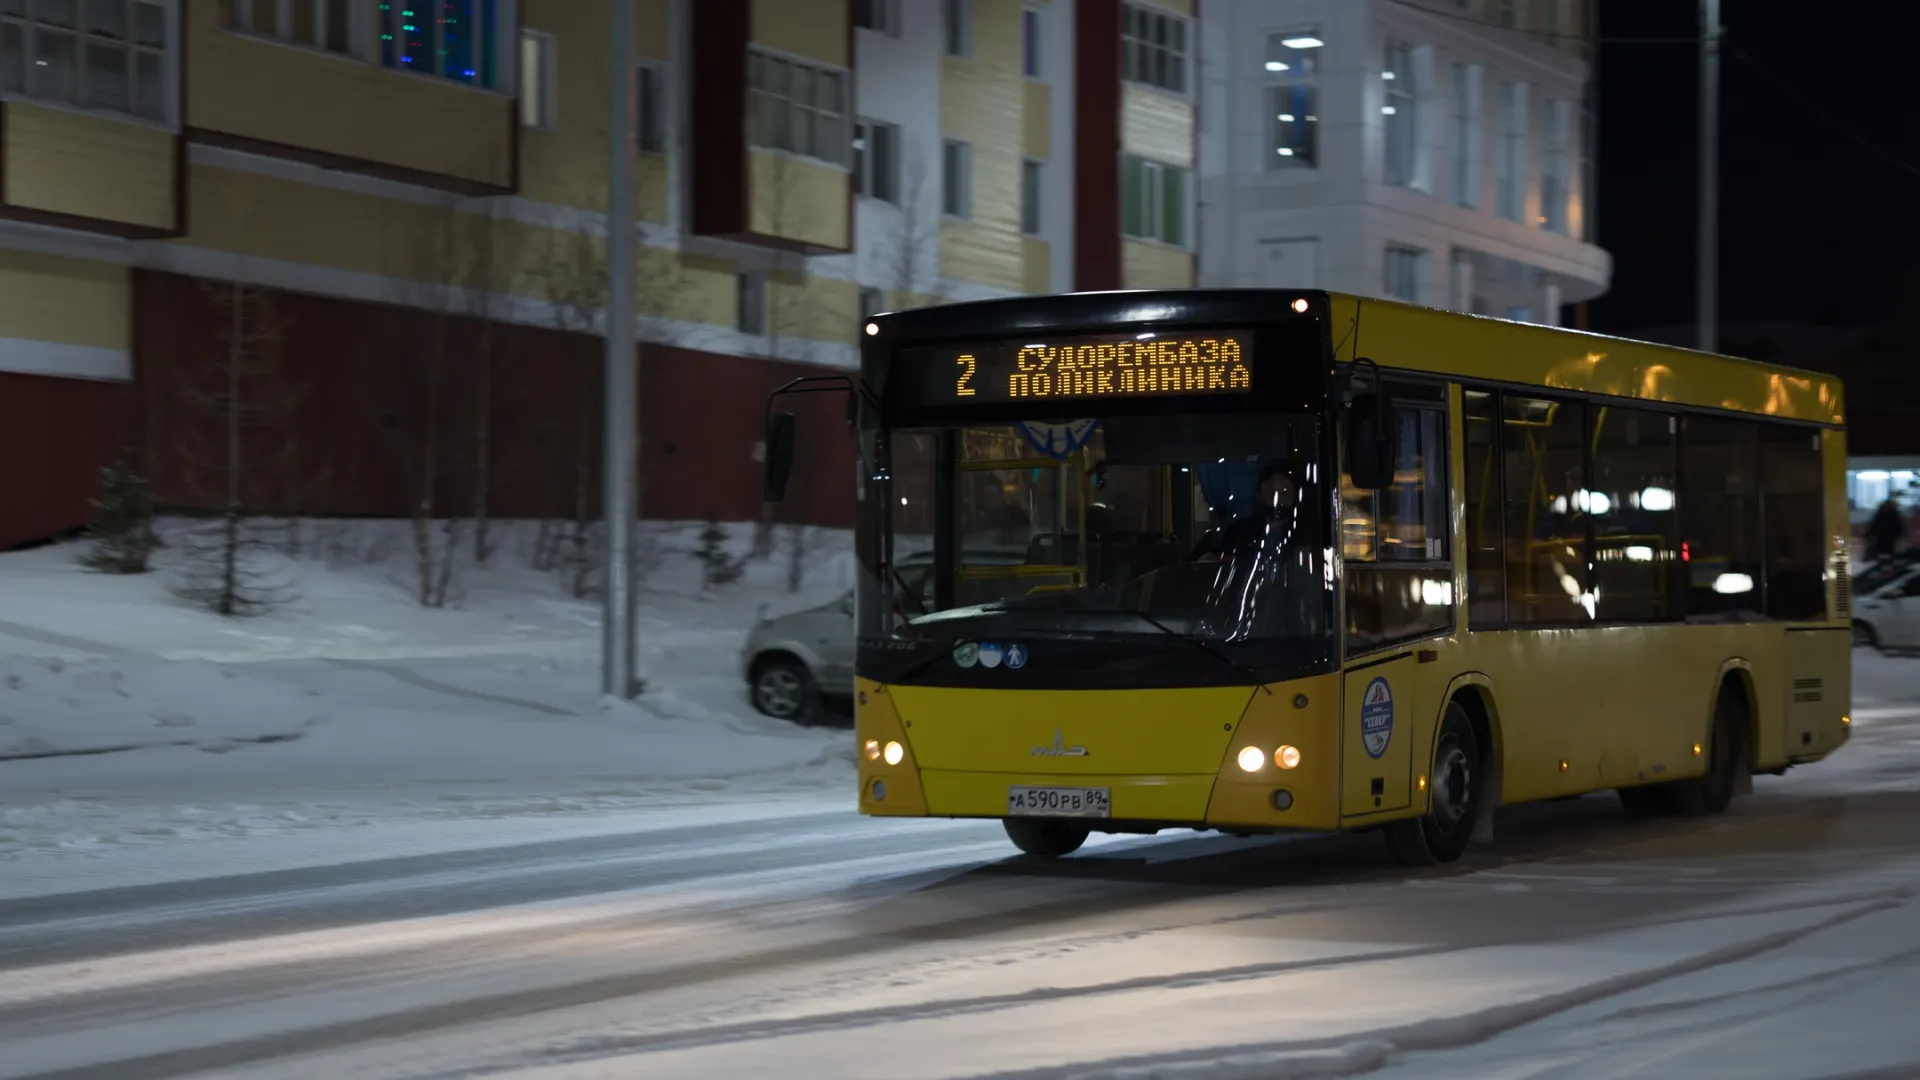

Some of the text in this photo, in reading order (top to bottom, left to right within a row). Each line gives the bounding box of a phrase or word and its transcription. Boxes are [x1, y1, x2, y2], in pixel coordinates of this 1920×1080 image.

[1017, 339, 1241, 372] СУДОРЕМБАЗА
[956, 354, 976, 397] 2
[1009, 364, 1249, 397] ПОЛИКЛИНИКА
[1086, 790, 1102, 805] 89
